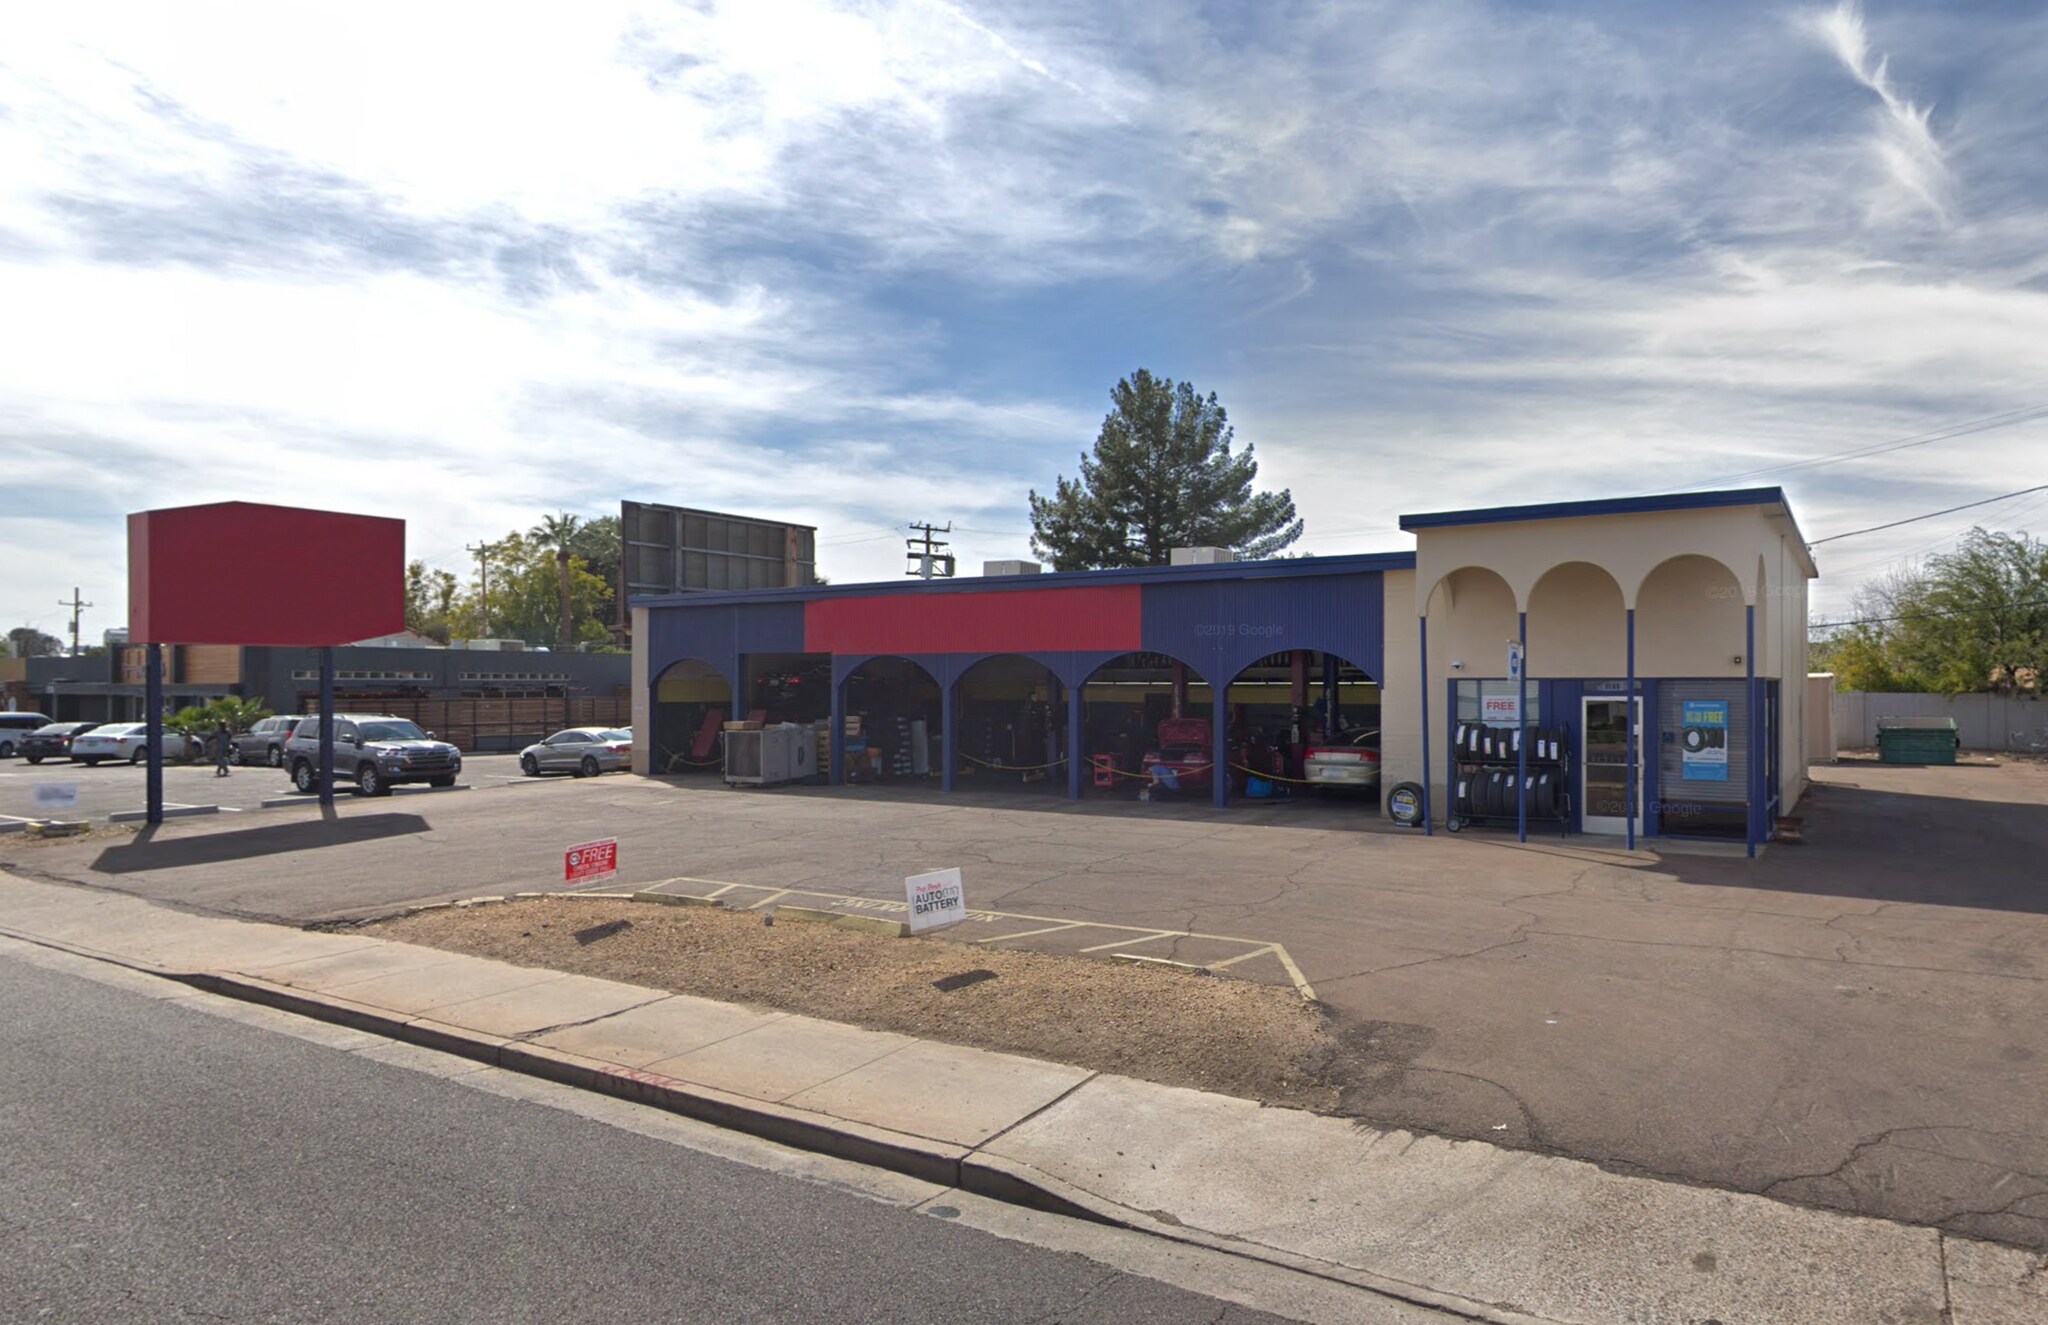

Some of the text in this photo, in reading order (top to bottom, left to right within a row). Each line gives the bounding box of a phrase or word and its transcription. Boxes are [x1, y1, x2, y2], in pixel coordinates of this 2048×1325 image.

[1486, 701, 1516, 711] FREE
[581, 846, 613, 863] FREE
[915, 890, 943, 904] AUTO
[915, 896, 959, 915] BATTERY
